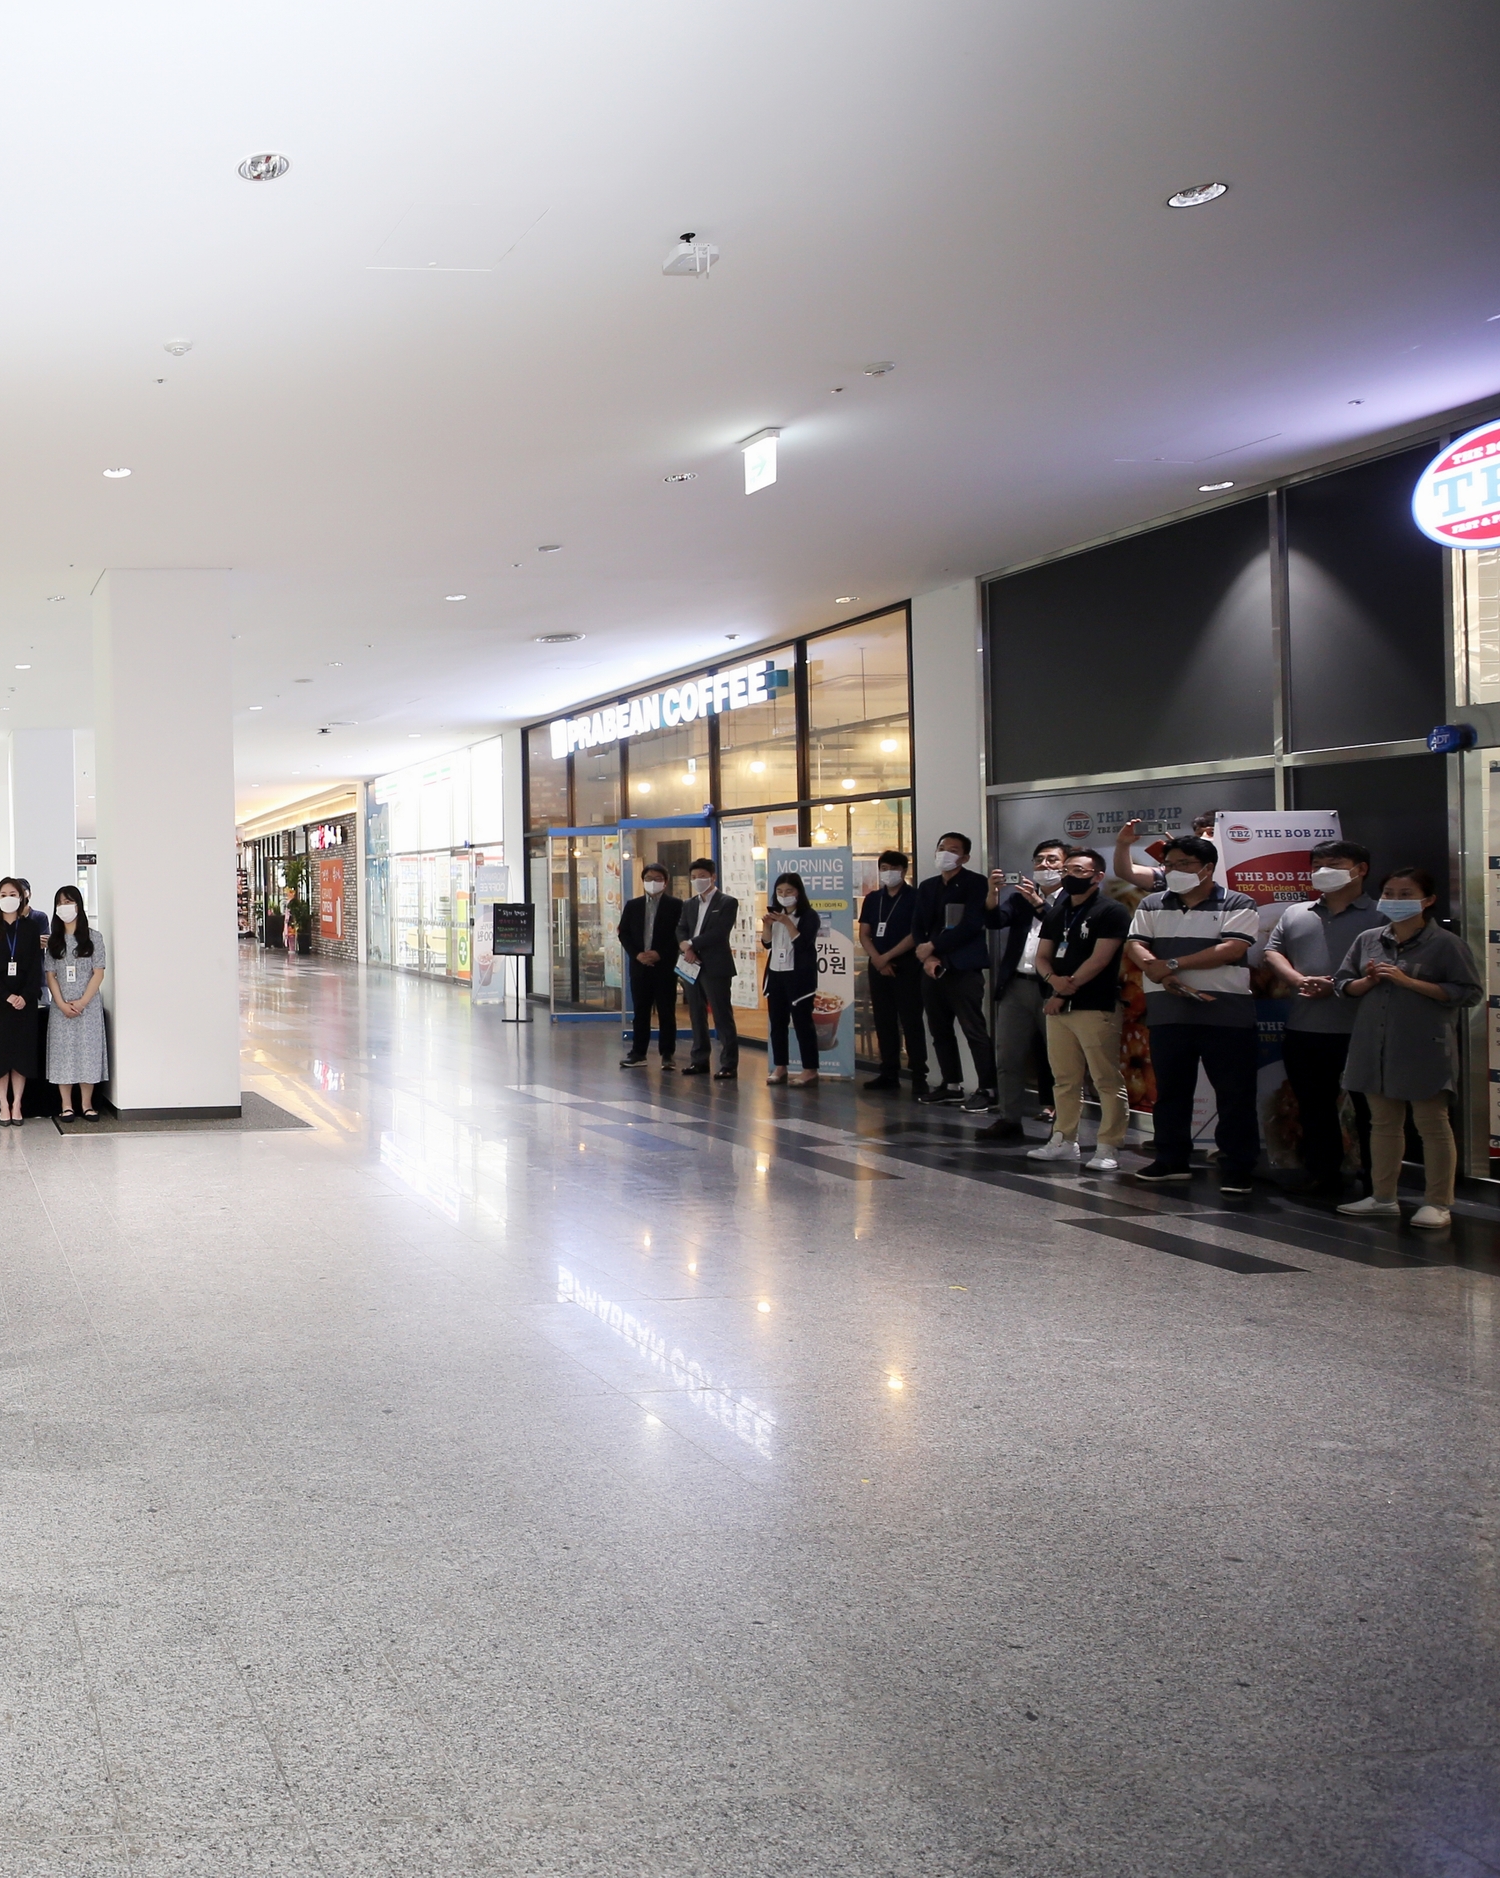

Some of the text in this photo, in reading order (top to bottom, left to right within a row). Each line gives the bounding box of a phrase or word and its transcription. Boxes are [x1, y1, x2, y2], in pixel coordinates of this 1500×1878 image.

[567, 660, 772, 753] PRABEAN COFFEE
[1431, 734, 1450, 744] ADT
[1097, 807, 1183, 823] THE BOB ZIP
[1067, 820, 1090, 831] TBZ
[1255, 830, 1282, 838] THE
[1285, 829, 1312, 838] BOB
[1314, 829, 1336, 838] ZIP
[776, 858, 844, 874] MORNING
[1235, 872, 1312, 881] THE BOB ZI
[801, 876, 844, 891] FFEE
[1236, 884, 1256, 892] TBZ
[1258, 883, 1297, 892] Chicken
[817, 943, 841, 955] 카노
[817, 956, 847, 975] 0원
